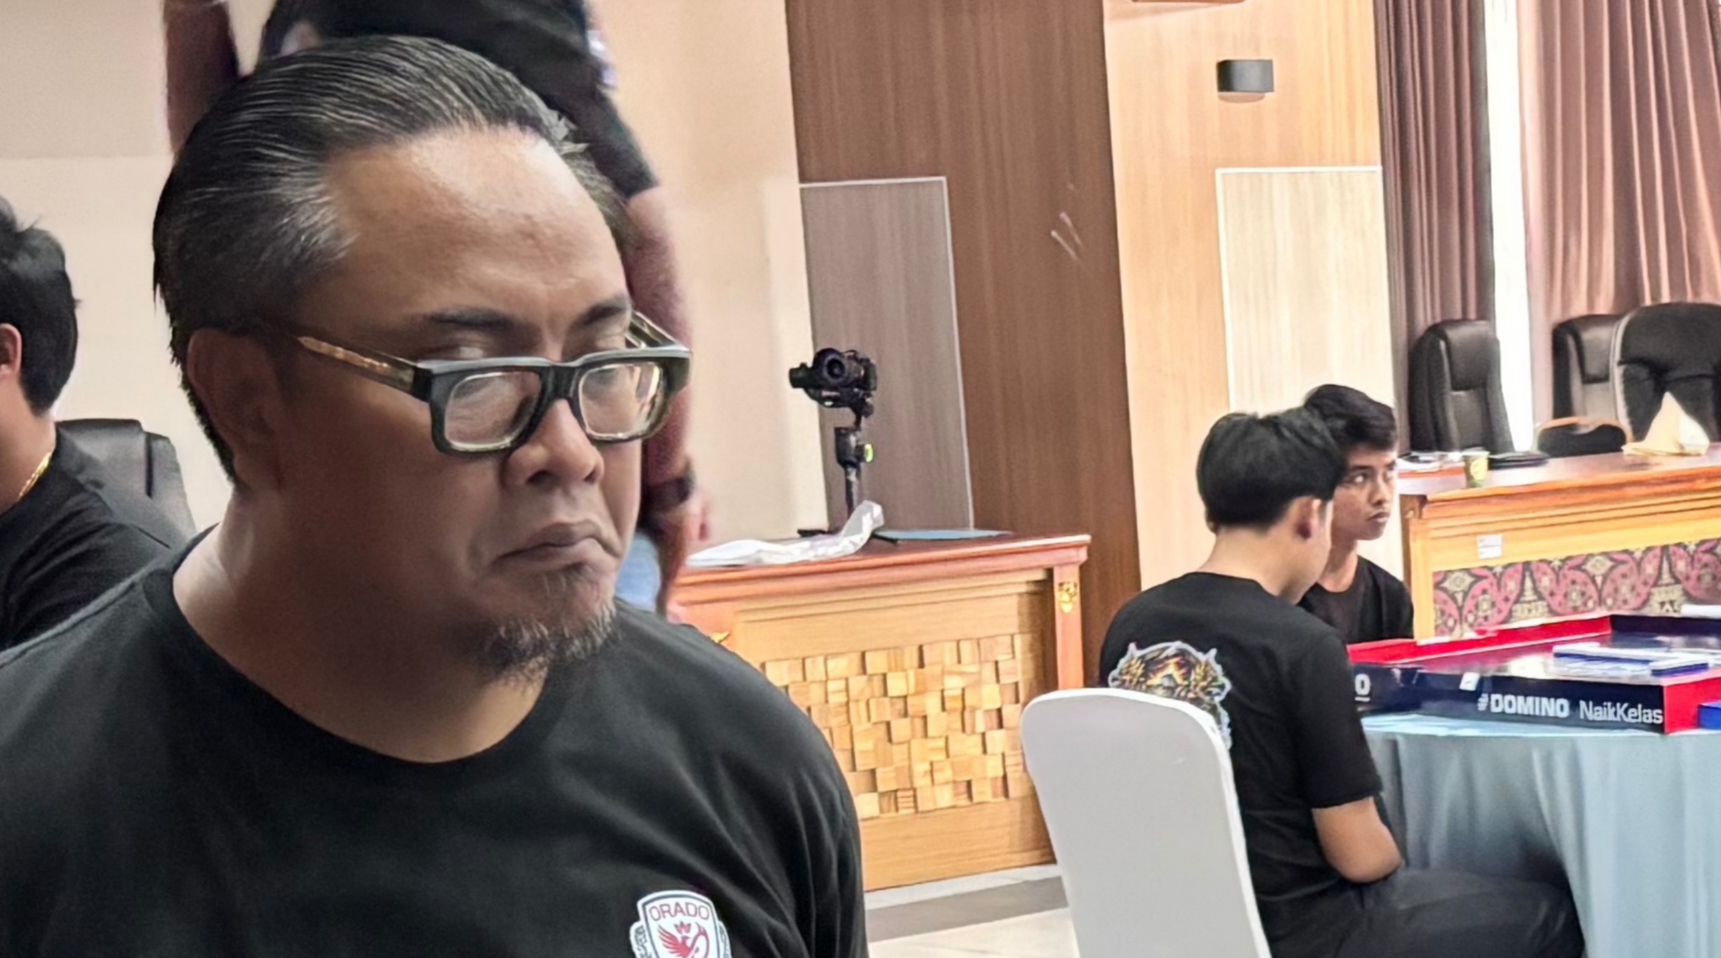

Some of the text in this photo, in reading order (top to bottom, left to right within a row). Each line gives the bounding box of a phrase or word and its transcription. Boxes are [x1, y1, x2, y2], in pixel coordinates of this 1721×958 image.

[1477, 694, 1664, 724] #DOMINO NaikKelas
[649, 902, 711, 921] ORADO
